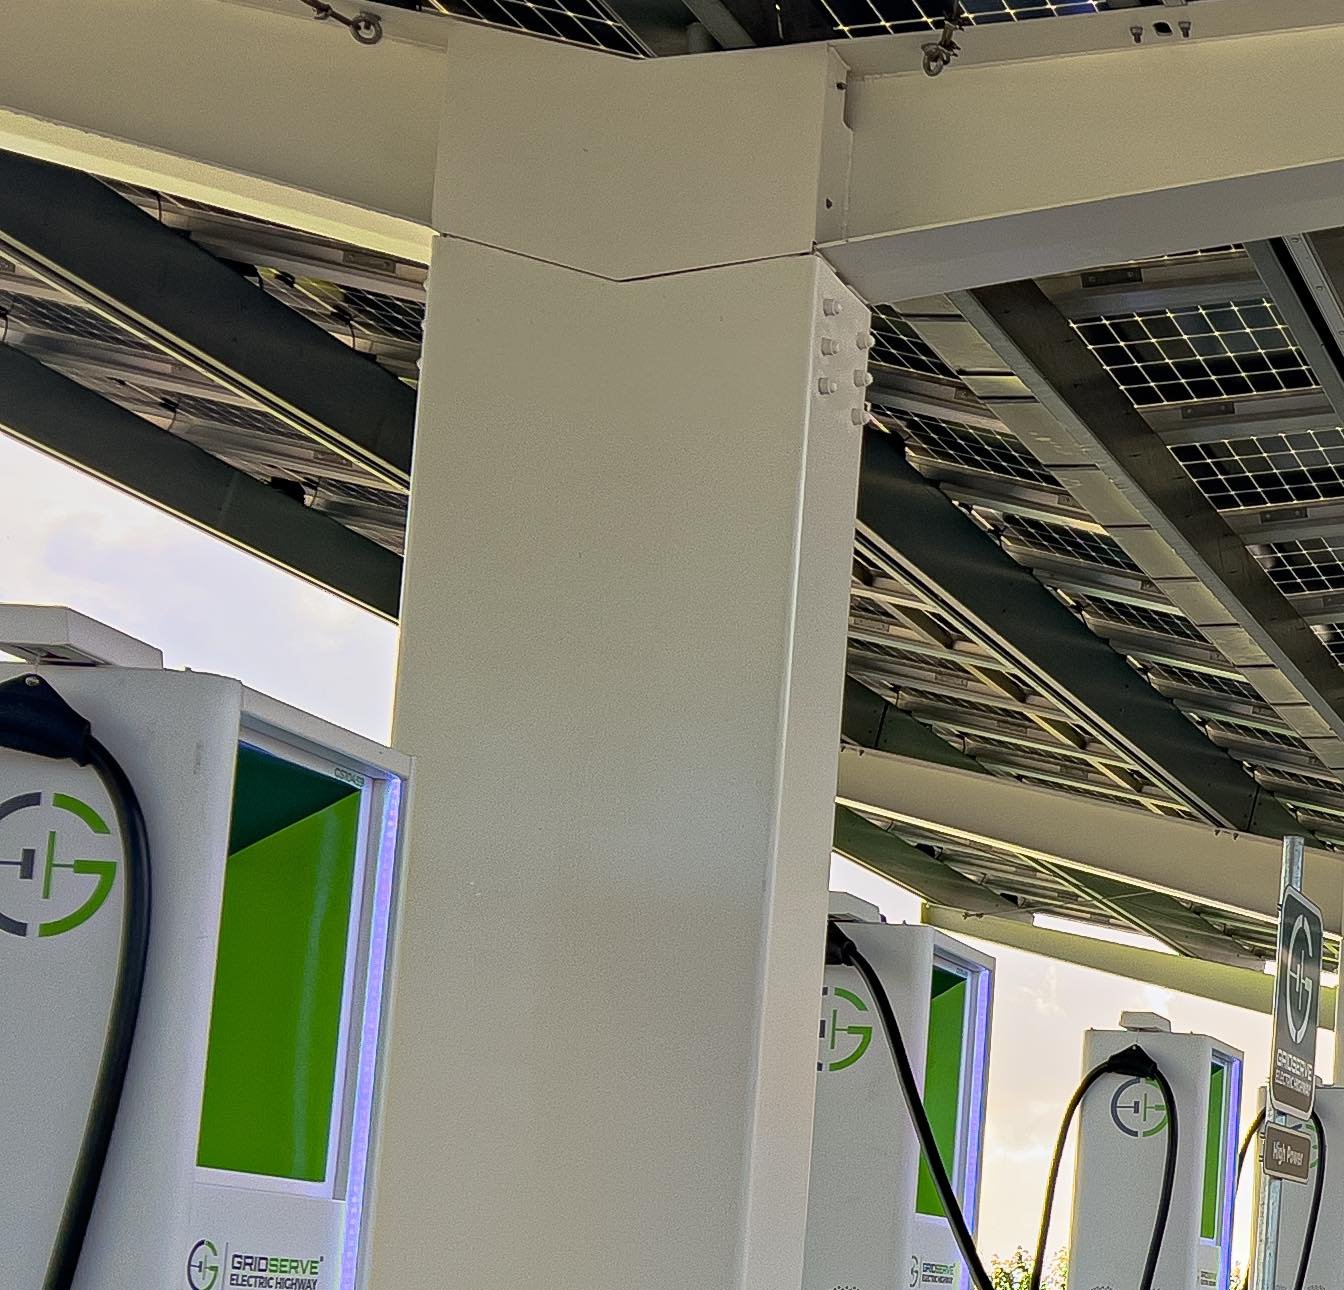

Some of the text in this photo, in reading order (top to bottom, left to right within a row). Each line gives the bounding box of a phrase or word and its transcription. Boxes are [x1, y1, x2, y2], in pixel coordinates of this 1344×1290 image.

[1273, 1141, 1304, 1166] High Power
[231, 1253, 320, 1275] GRIDSERVE
[229, 1274, 318, 1290] ELECTRIC HIGHWAY
